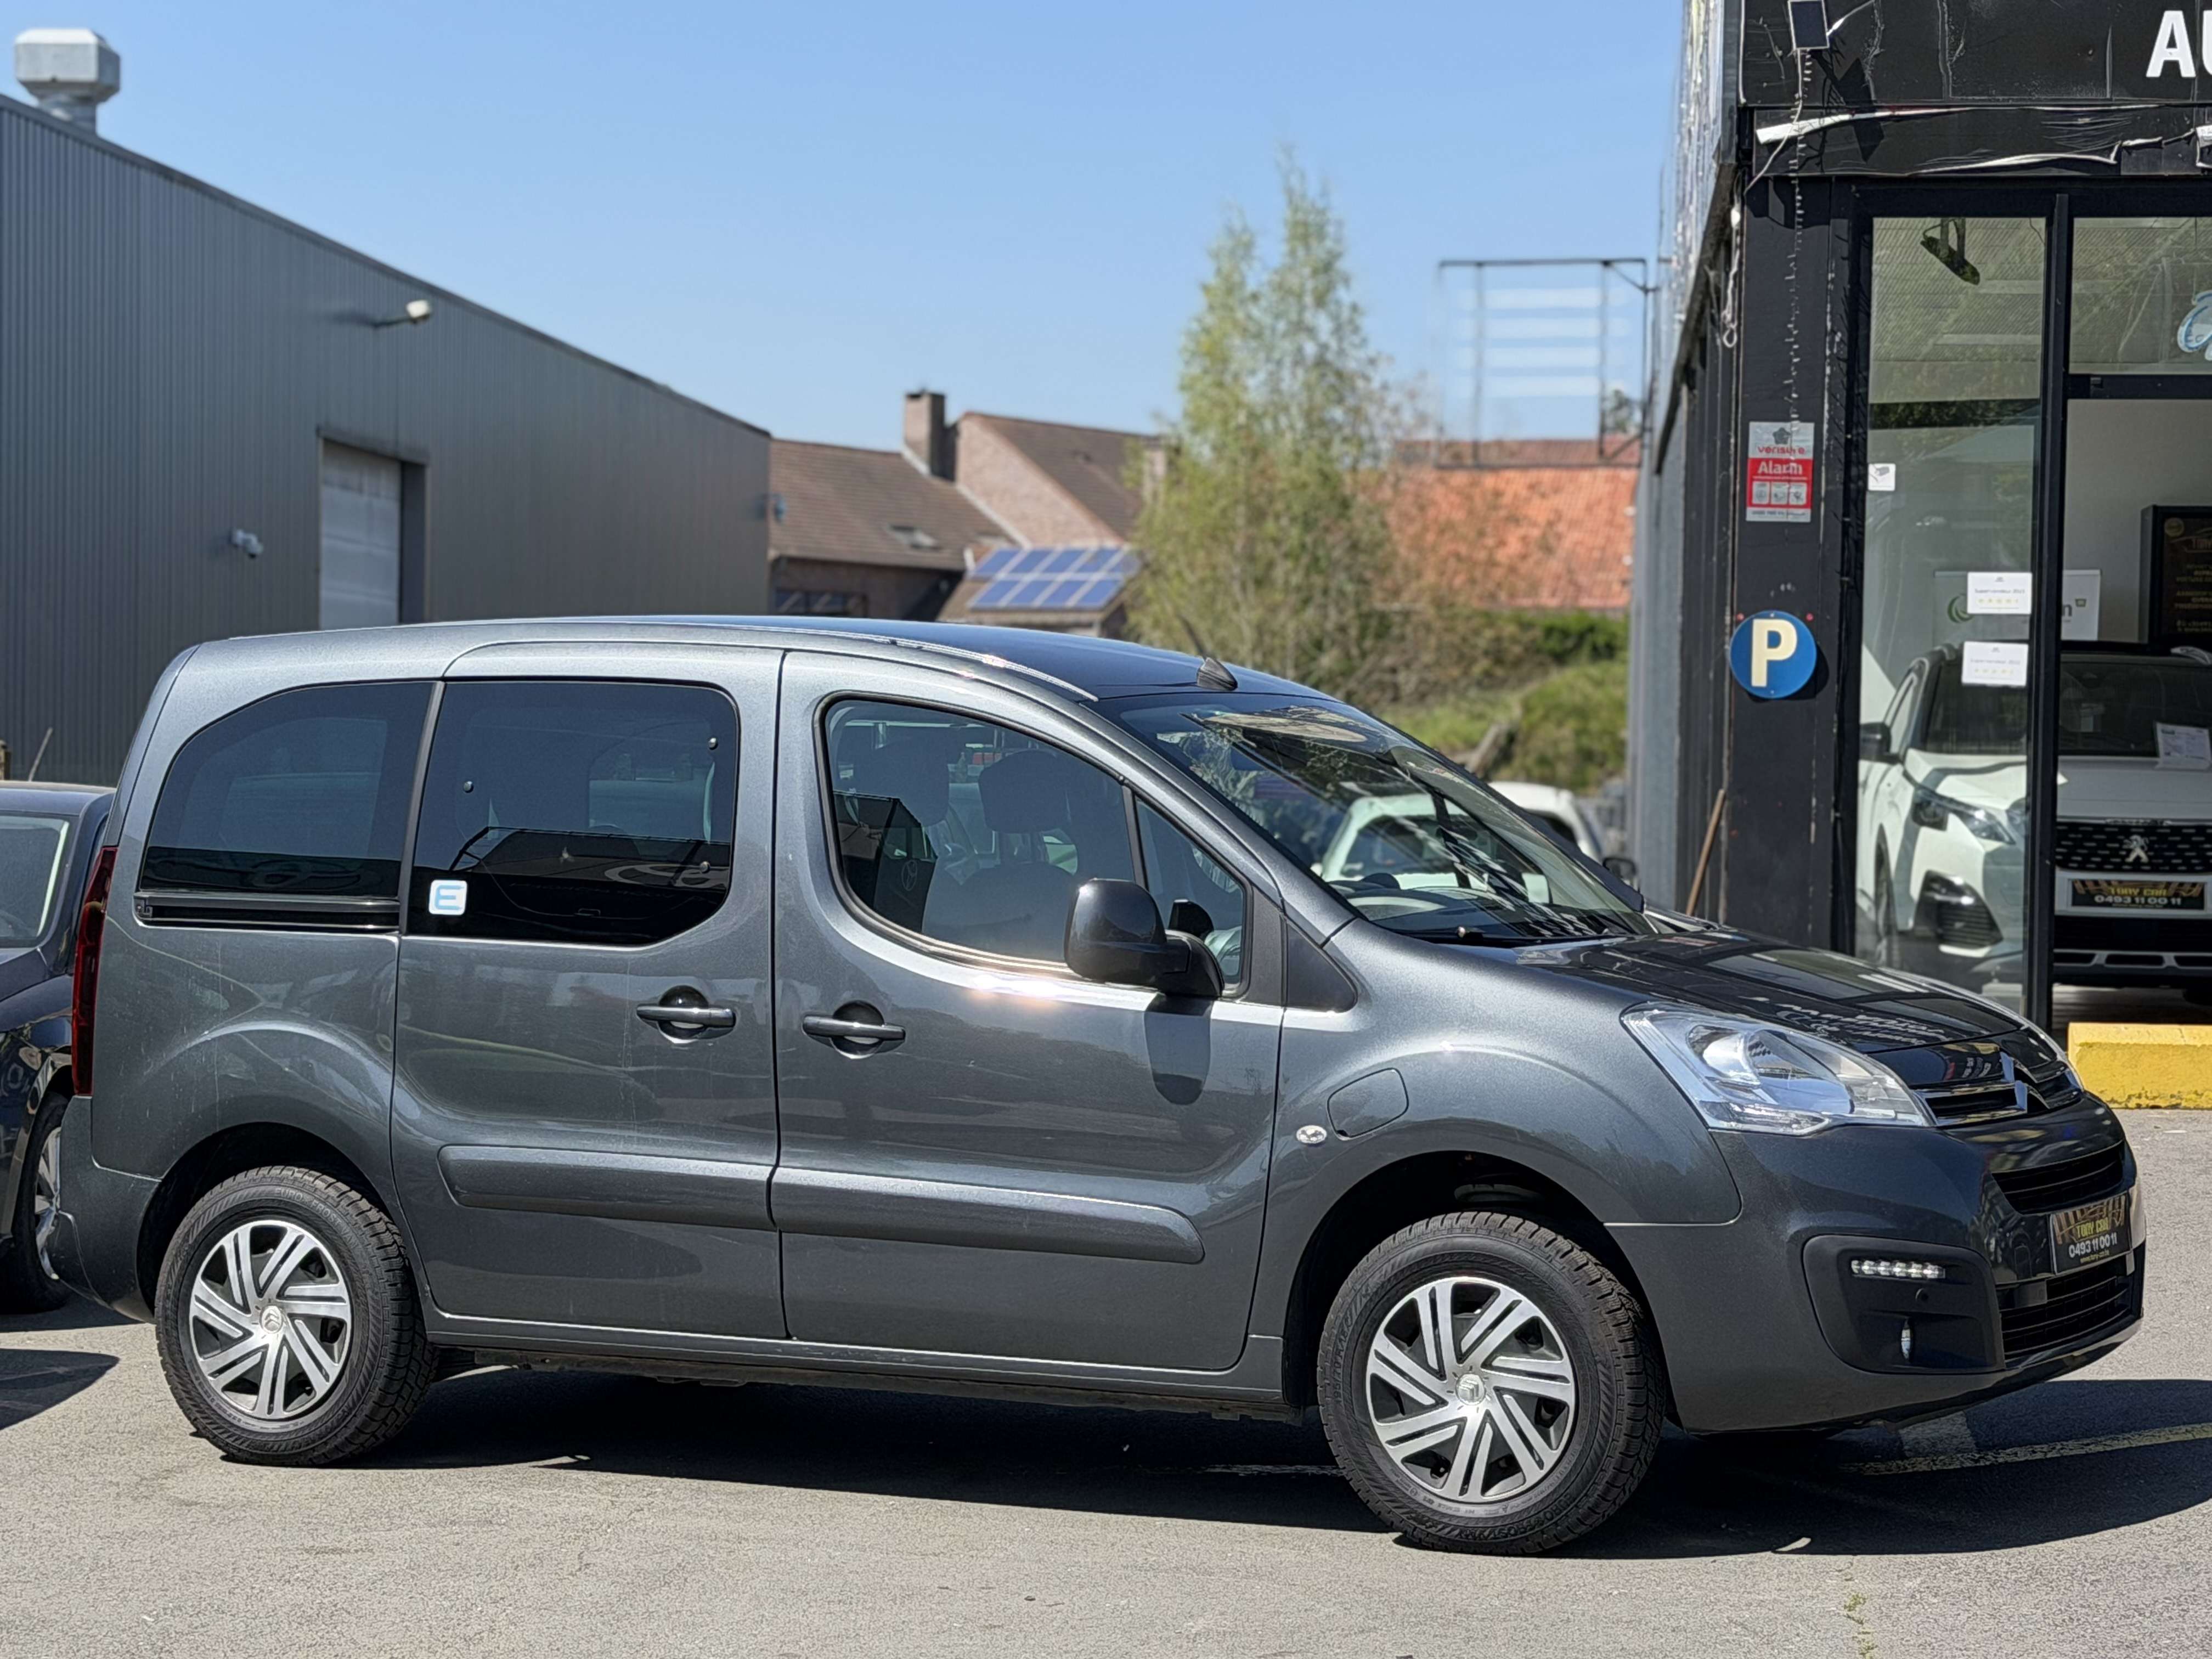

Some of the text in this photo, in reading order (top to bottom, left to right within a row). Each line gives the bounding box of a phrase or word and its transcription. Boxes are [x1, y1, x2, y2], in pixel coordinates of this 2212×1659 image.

[2146, 10, 2212, 77] A
[1758, 460, 1803, 475] Alarm
[1752, 619, 1797, 687] P
[2094, 895, 2131, 904] 0493
[2069, 1232, 2118, 1258] 0493 11 00 11
